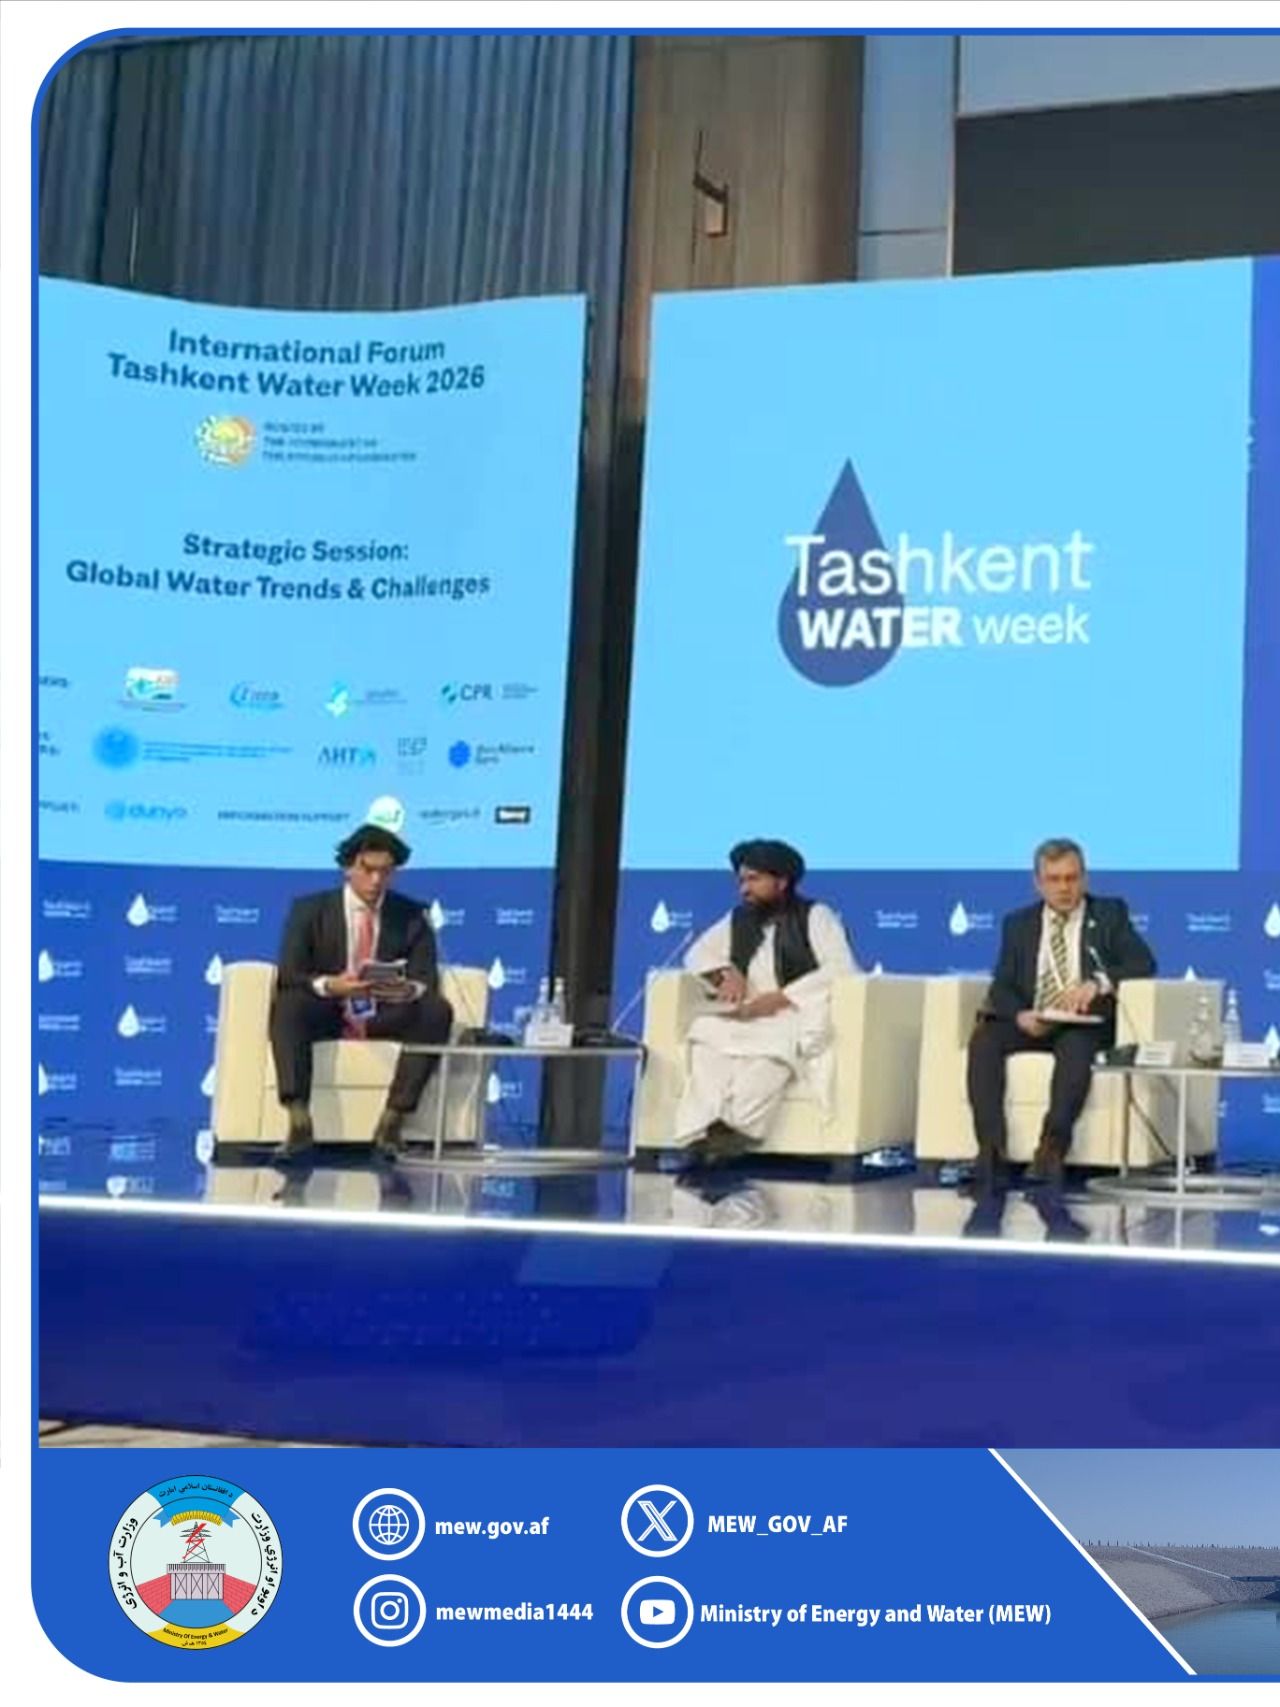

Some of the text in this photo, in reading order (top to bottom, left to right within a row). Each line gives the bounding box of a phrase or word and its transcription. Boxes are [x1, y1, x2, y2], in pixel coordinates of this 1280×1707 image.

[169, 328, 445, 364] International Forum
[107, 352, 485, 397] Tashkent Water Week 2026
[183, 533, 408, 566] Strategic Session:
[784, 530, 1095, 597] Tashkent
[66, 560, 490, 600] Global Water Trends & Challenges
[797, 603, 1090, 648] WATER week
[460, 684, 493, 701] CPR
